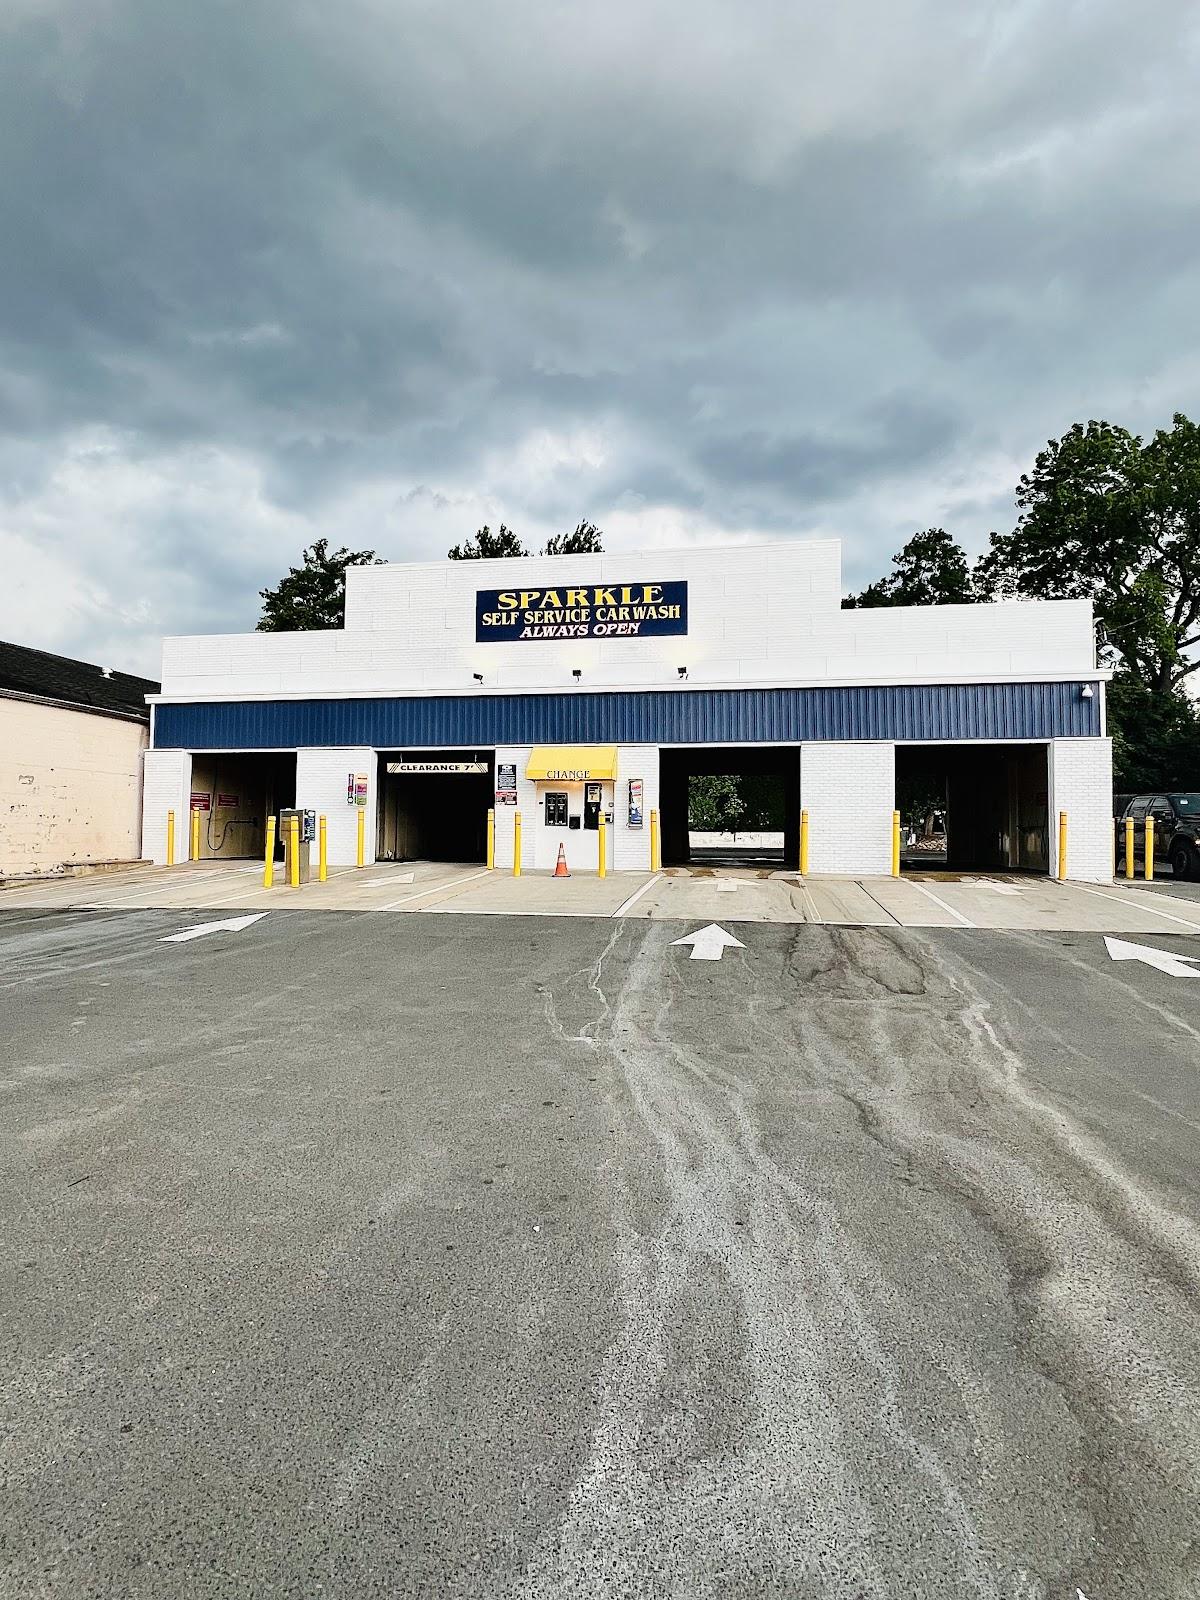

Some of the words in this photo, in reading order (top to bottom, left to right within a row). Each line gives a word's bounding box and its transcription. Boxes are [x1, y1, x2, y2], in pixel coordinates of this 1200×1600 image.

[497, 585, 665, 610] SPARKLE
[482, 611, 520, 626] SELF
[523, 608, 591, 625] SERVICE
[595, 606, 633, 622] CAR
[633, 604, 681, 620] WASH
[519, 624, 589, 639] ALWAYS
[592, 622, 641, 636] OPEN
[546, 770, 591, 779] CHANGE
